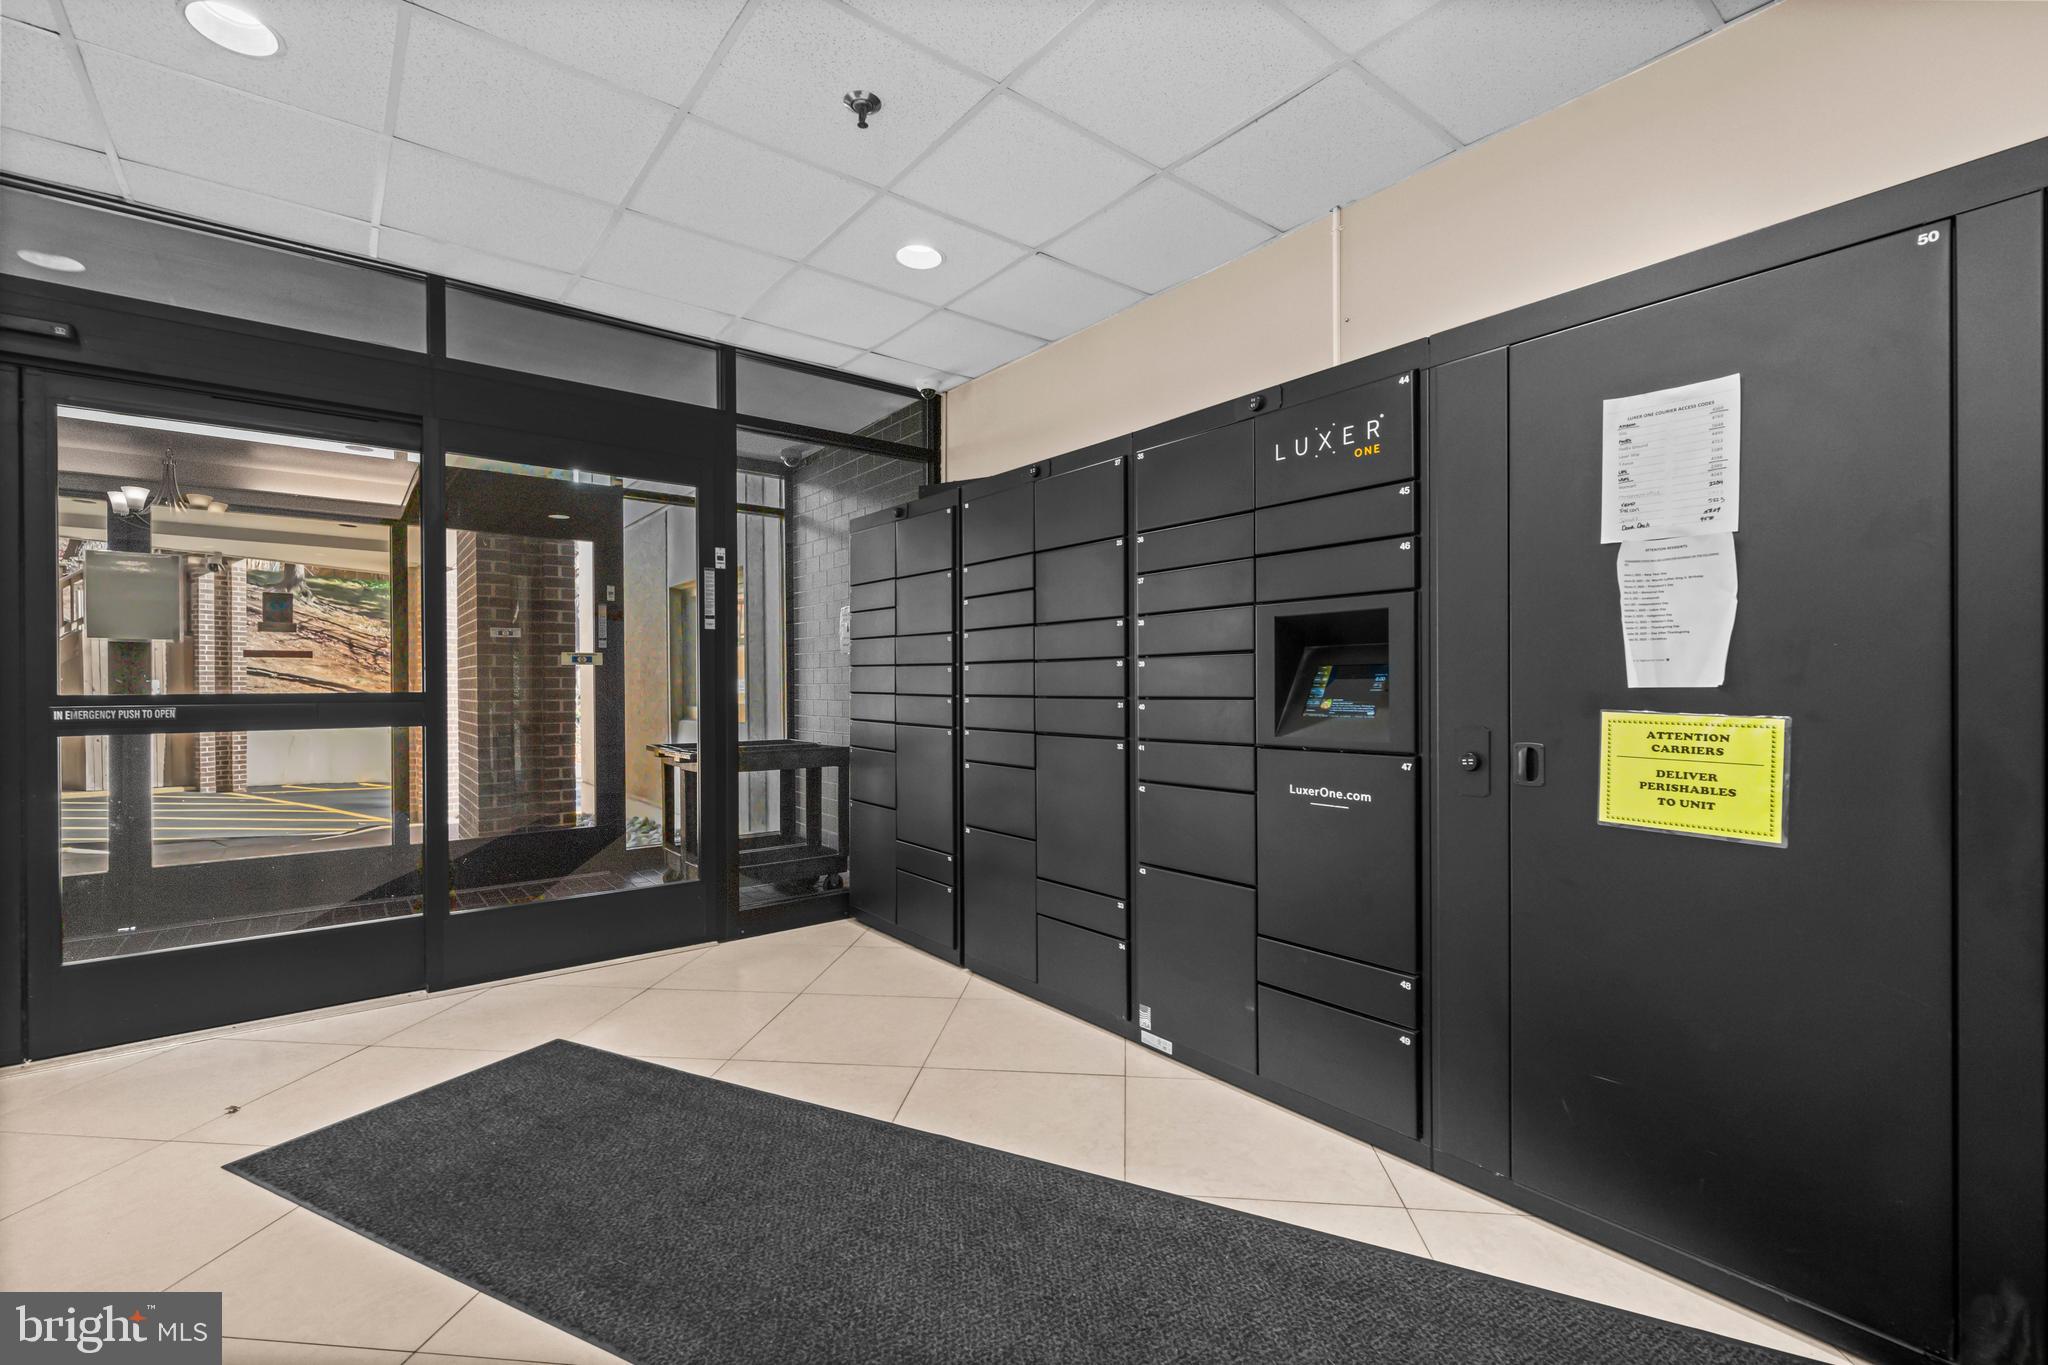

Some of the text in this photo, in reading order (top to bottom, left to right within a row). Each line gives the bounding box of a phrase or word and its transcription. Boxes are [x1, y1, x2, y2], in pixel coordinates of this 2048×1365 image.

[1917, 230, 1940, 246] 50
[1398, 375, 1410, 385] 44
[1275, 419, 1380, 462] LUXER
[1354, 443, 1381, 458] ONE
[1399, 486, 1411, 495] 45
[1399, 541, 1411, 551] 46
[53, 708, 176, 720] IN EMERGENCY PUSH TO OPEN
[1646, 730, 1731, 743] ATTENTION
[1651, 744, 1725, 756] CARRIERS
[1401, 763, 1412, 771] 47
[1656, 769, 1719, 783] DELIVER
[1289, 784, 1372, 802] LuxerOne.com
[1639, 781, 1737, 798] PERISHABLES
[1657, 797, 1716, 811] TO UNIT
[1400, 980, 1411, 990] 48
[1399, 1036, 1411, 1046] 49
